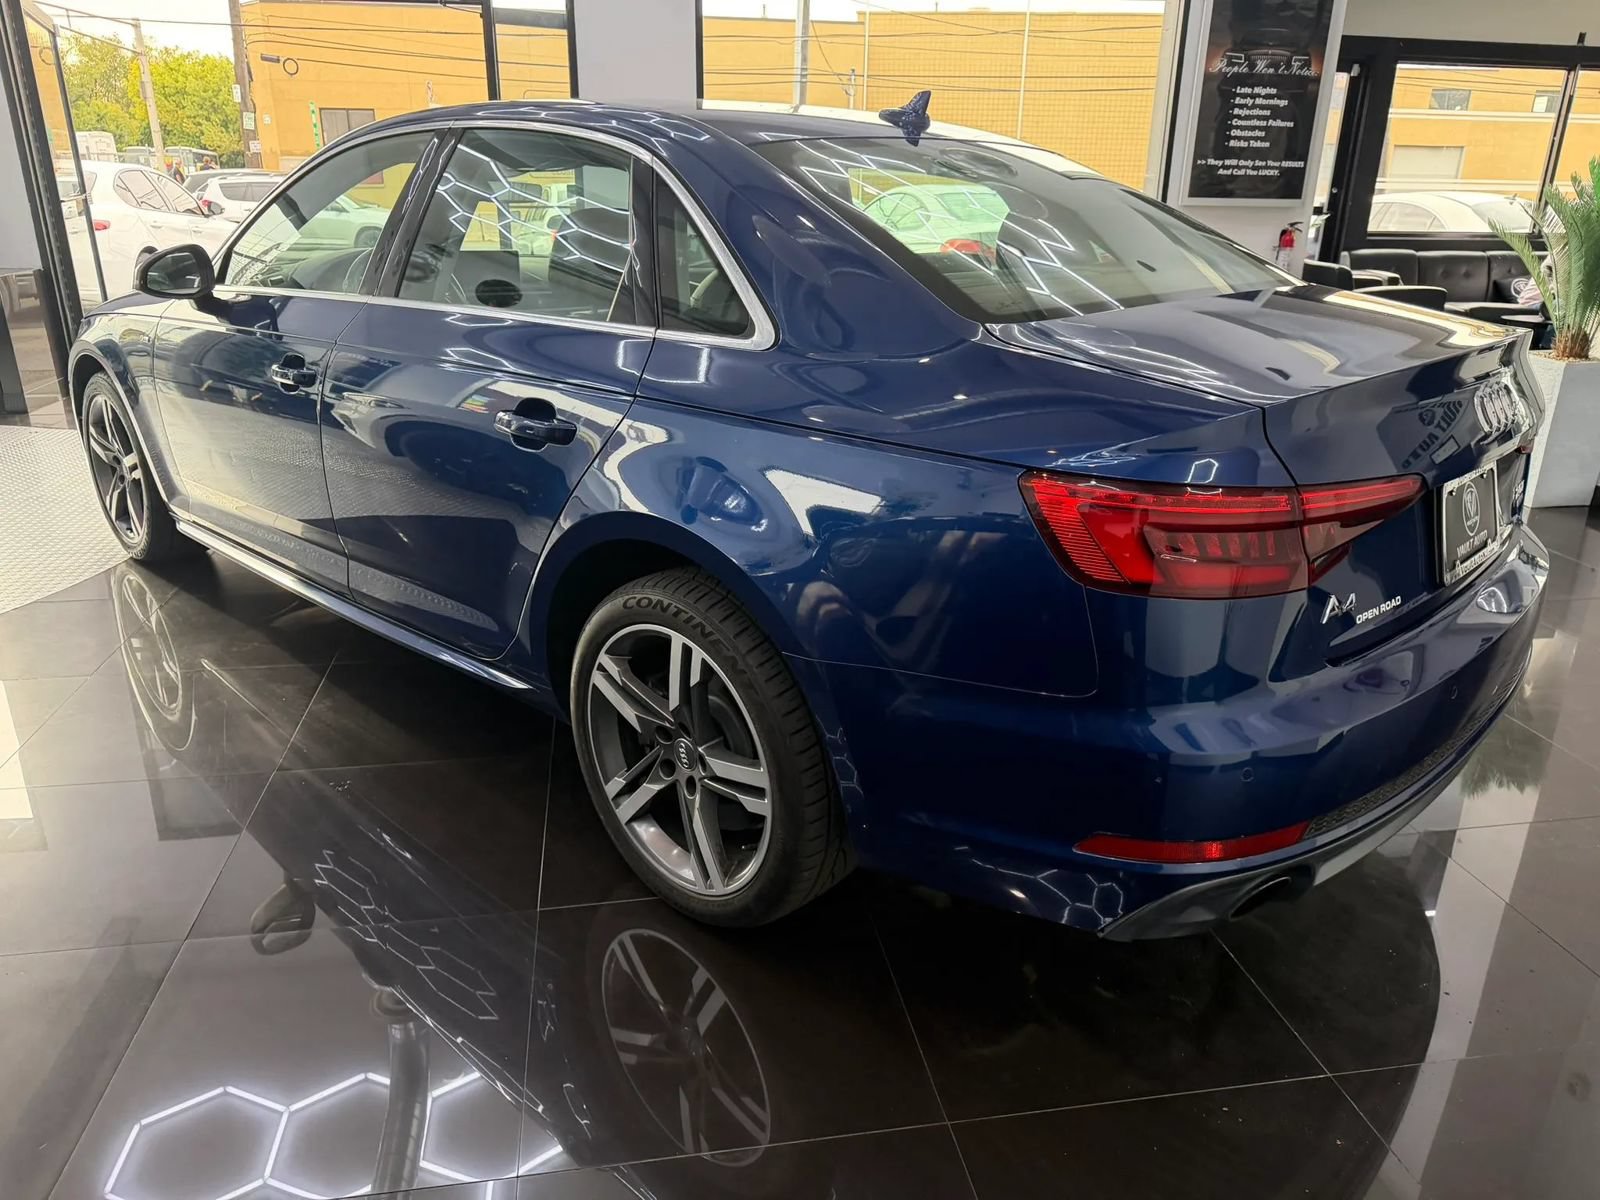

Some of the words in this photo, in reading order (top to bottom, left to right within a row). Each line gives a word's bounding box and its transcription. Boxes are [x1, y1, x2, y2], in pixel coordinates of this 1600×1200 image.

[1209, 58, 1249, 77] People
[1236, 86, 1252, 94] Late
[1253, 86, 1277, 96] Nights
[1234, 97, 1254, 106] Early
[1255, 98, 1288, 106] Mornings
[1233, 108, 1271, 117] Rejections
[1232, 118, 1266, 127] Countless
[1268, 119, 1294, 128] Failures
[1230, 129, 1265, 137] Obstacles
[1207, 159, 1224, 167] They
[1239, 160, 1253, 168] Only
[1320, 593, 1357, 624] A4
[1356, 606, 1379, 624] OPEN
[1380, 595, 1402, 614] ROAD
